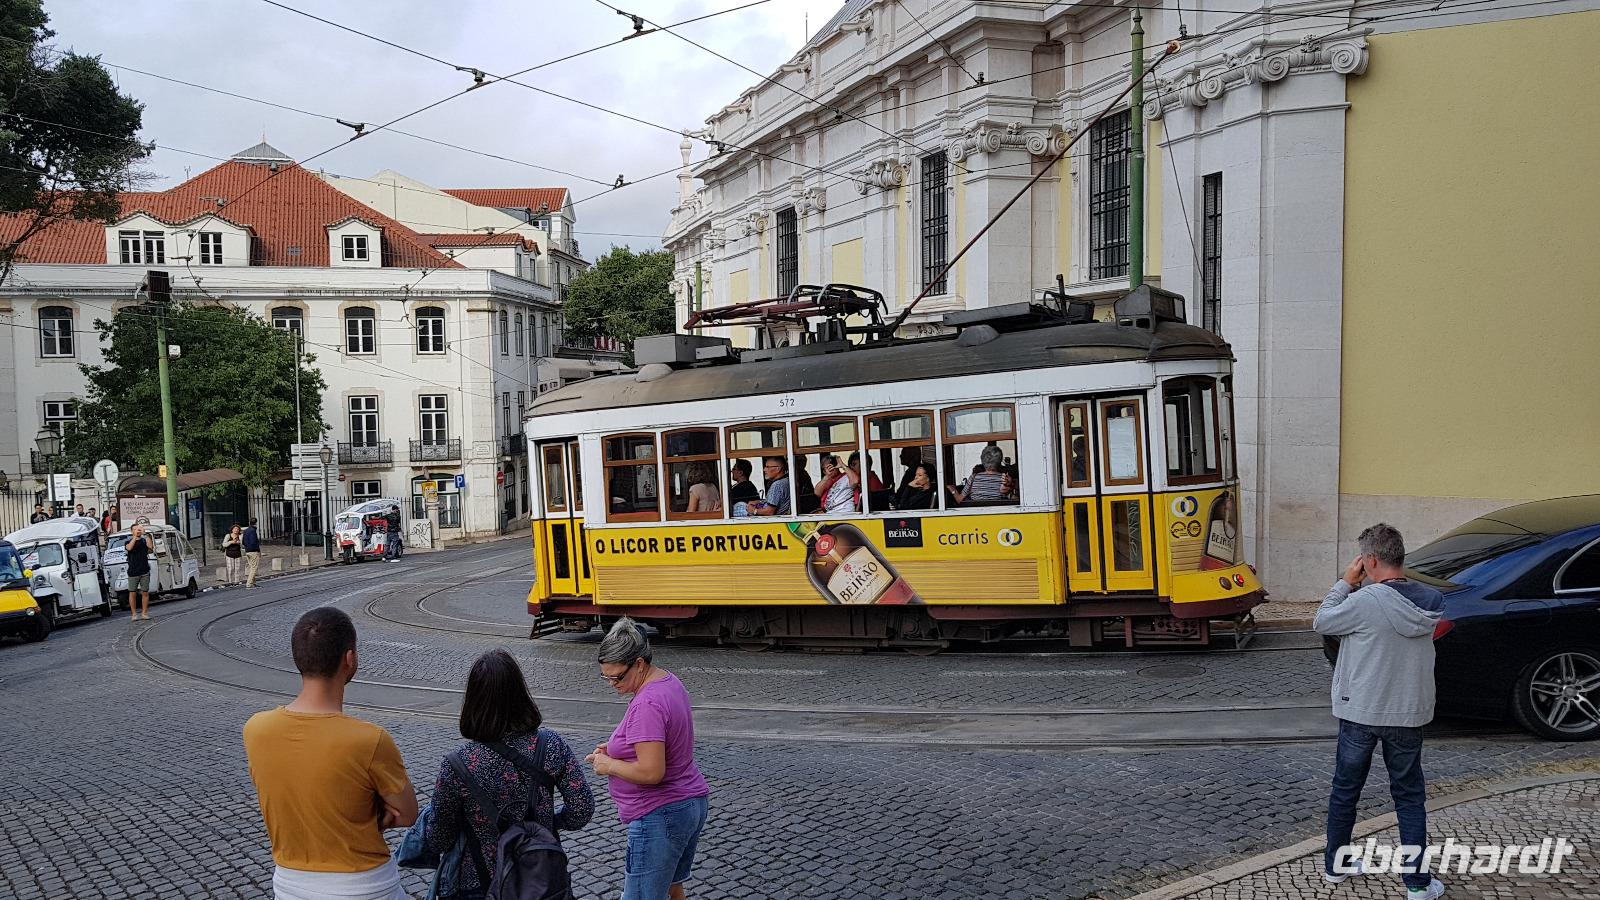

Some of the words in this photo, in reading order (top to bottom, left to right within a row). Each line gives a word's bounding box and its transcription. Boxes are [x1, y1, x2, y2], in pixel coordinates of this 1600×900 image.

[779, 398, 795, 407] 572
[595, 538, 605, 554] O
[610, 537, 659, 554] LICOR
[664, 536, 687, 553] DE
[691, 533, 789, 552] PORTUGAL
[938, 528, 989, 546] carris
[839, 561, 878, 602] BEIRÃO
